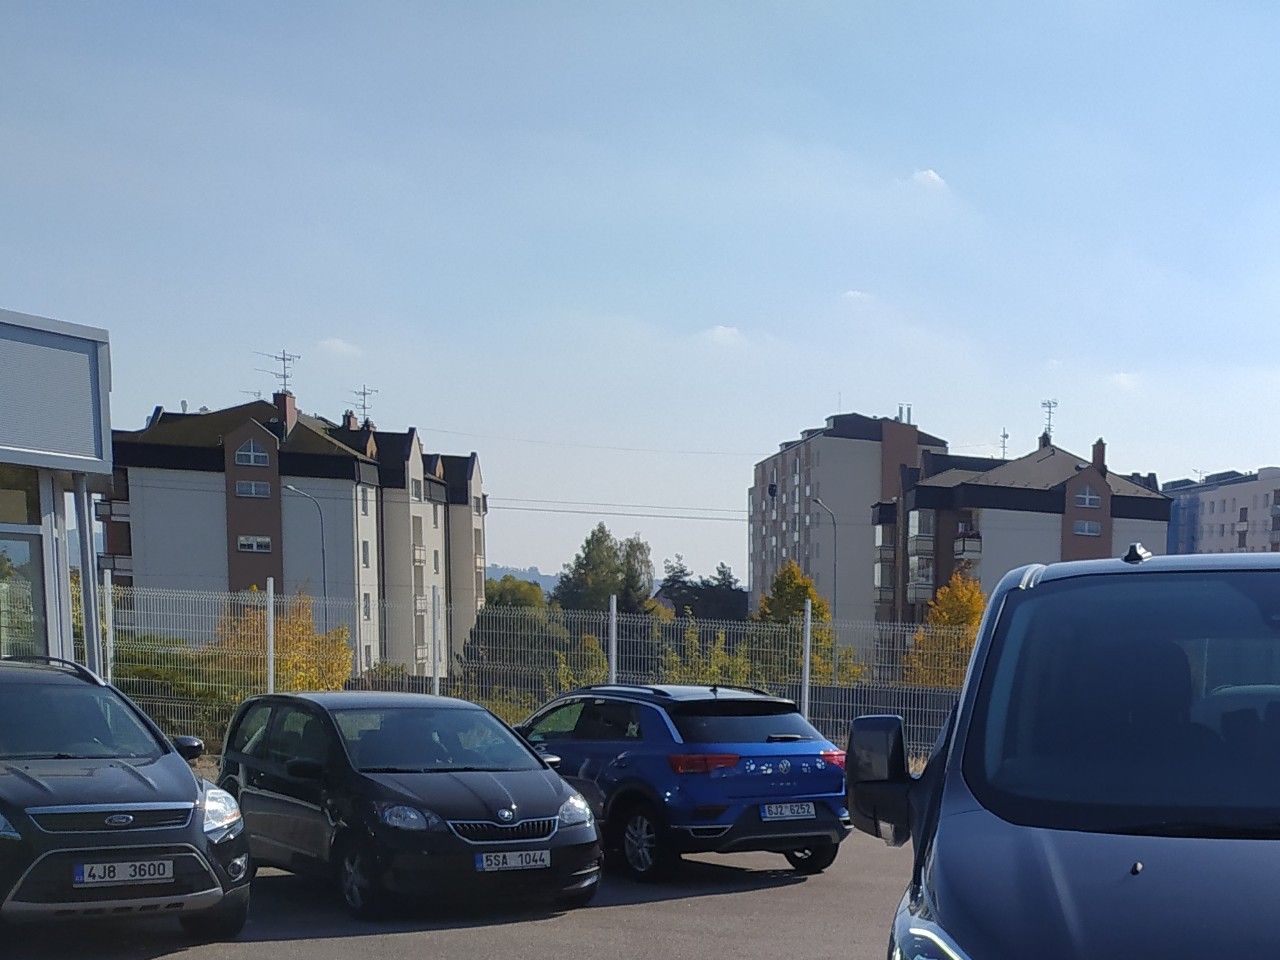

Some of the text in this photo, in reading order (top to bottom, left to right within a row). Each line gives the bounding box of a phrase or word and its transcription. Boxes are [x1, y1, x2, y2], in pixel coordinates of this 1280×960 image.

[485, 852, 545, 867] 5SA 1044
[87, 864, 117, 880] 4J8
[128, 862, 166, 878] 3600
